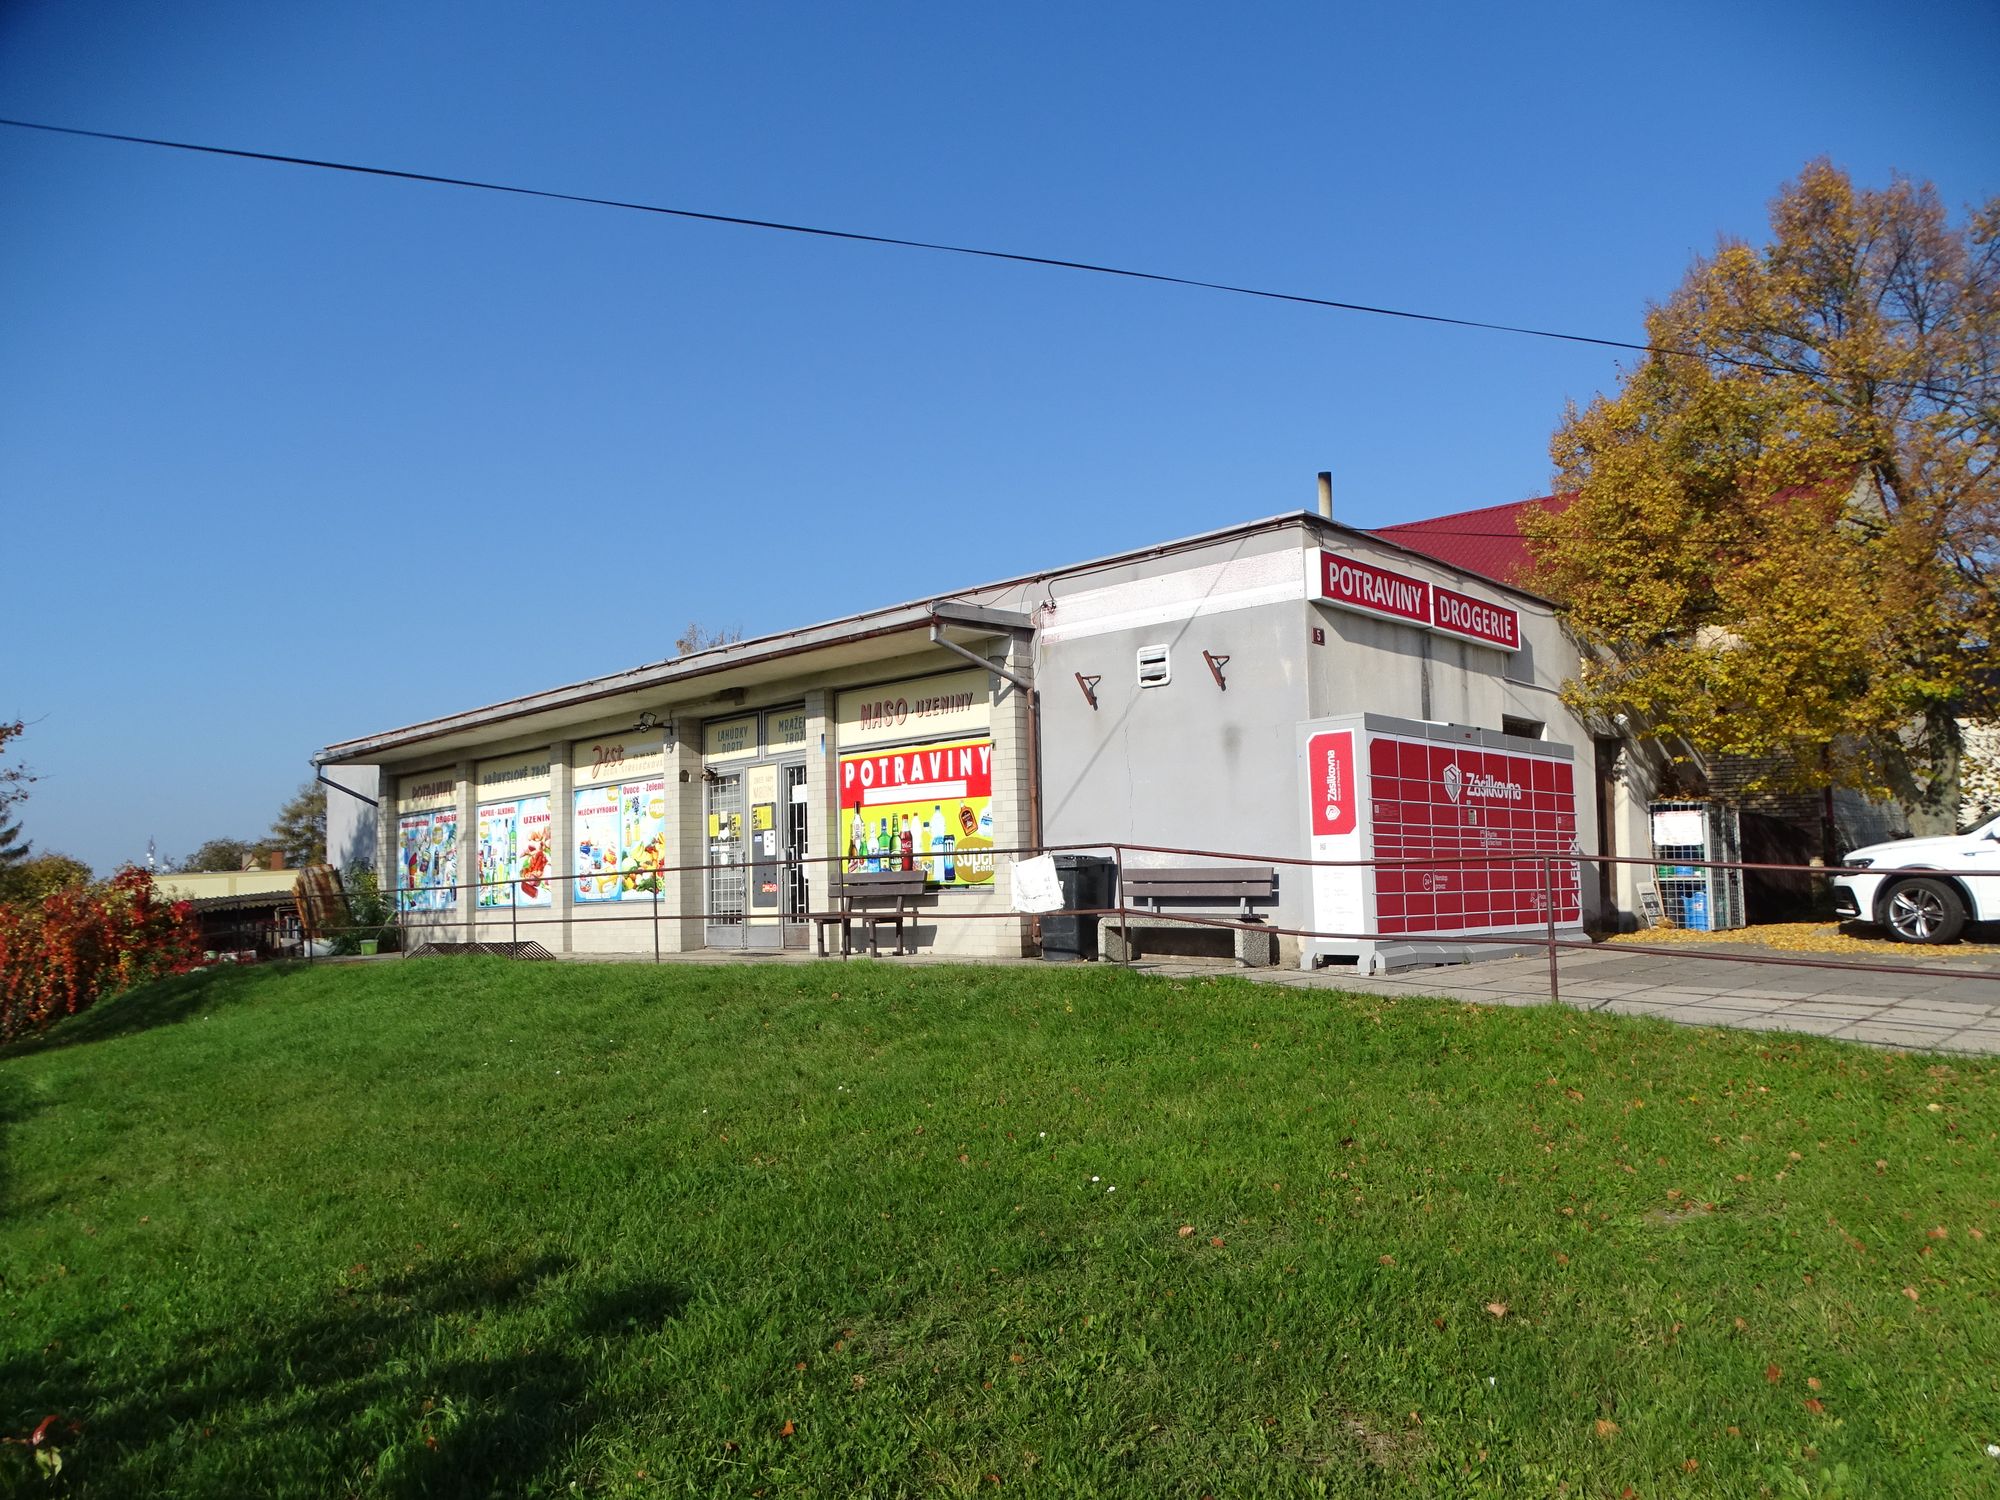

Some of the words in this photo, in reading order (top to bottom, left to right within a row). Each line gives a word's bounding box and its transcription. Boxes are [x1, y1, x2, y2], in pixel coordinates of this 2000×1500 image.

[1329, 561, 1422, 614] POTRAVINY
[1439, 595, 1513, 641] DROGERIE
[860, 697, 908, 730] MASO
[845, 746, 991, 788] POTRAVINY
[1327, 749, 1337, 802] Zásilkovna
[1466, 772, 1522, 800] Zásilkovna
